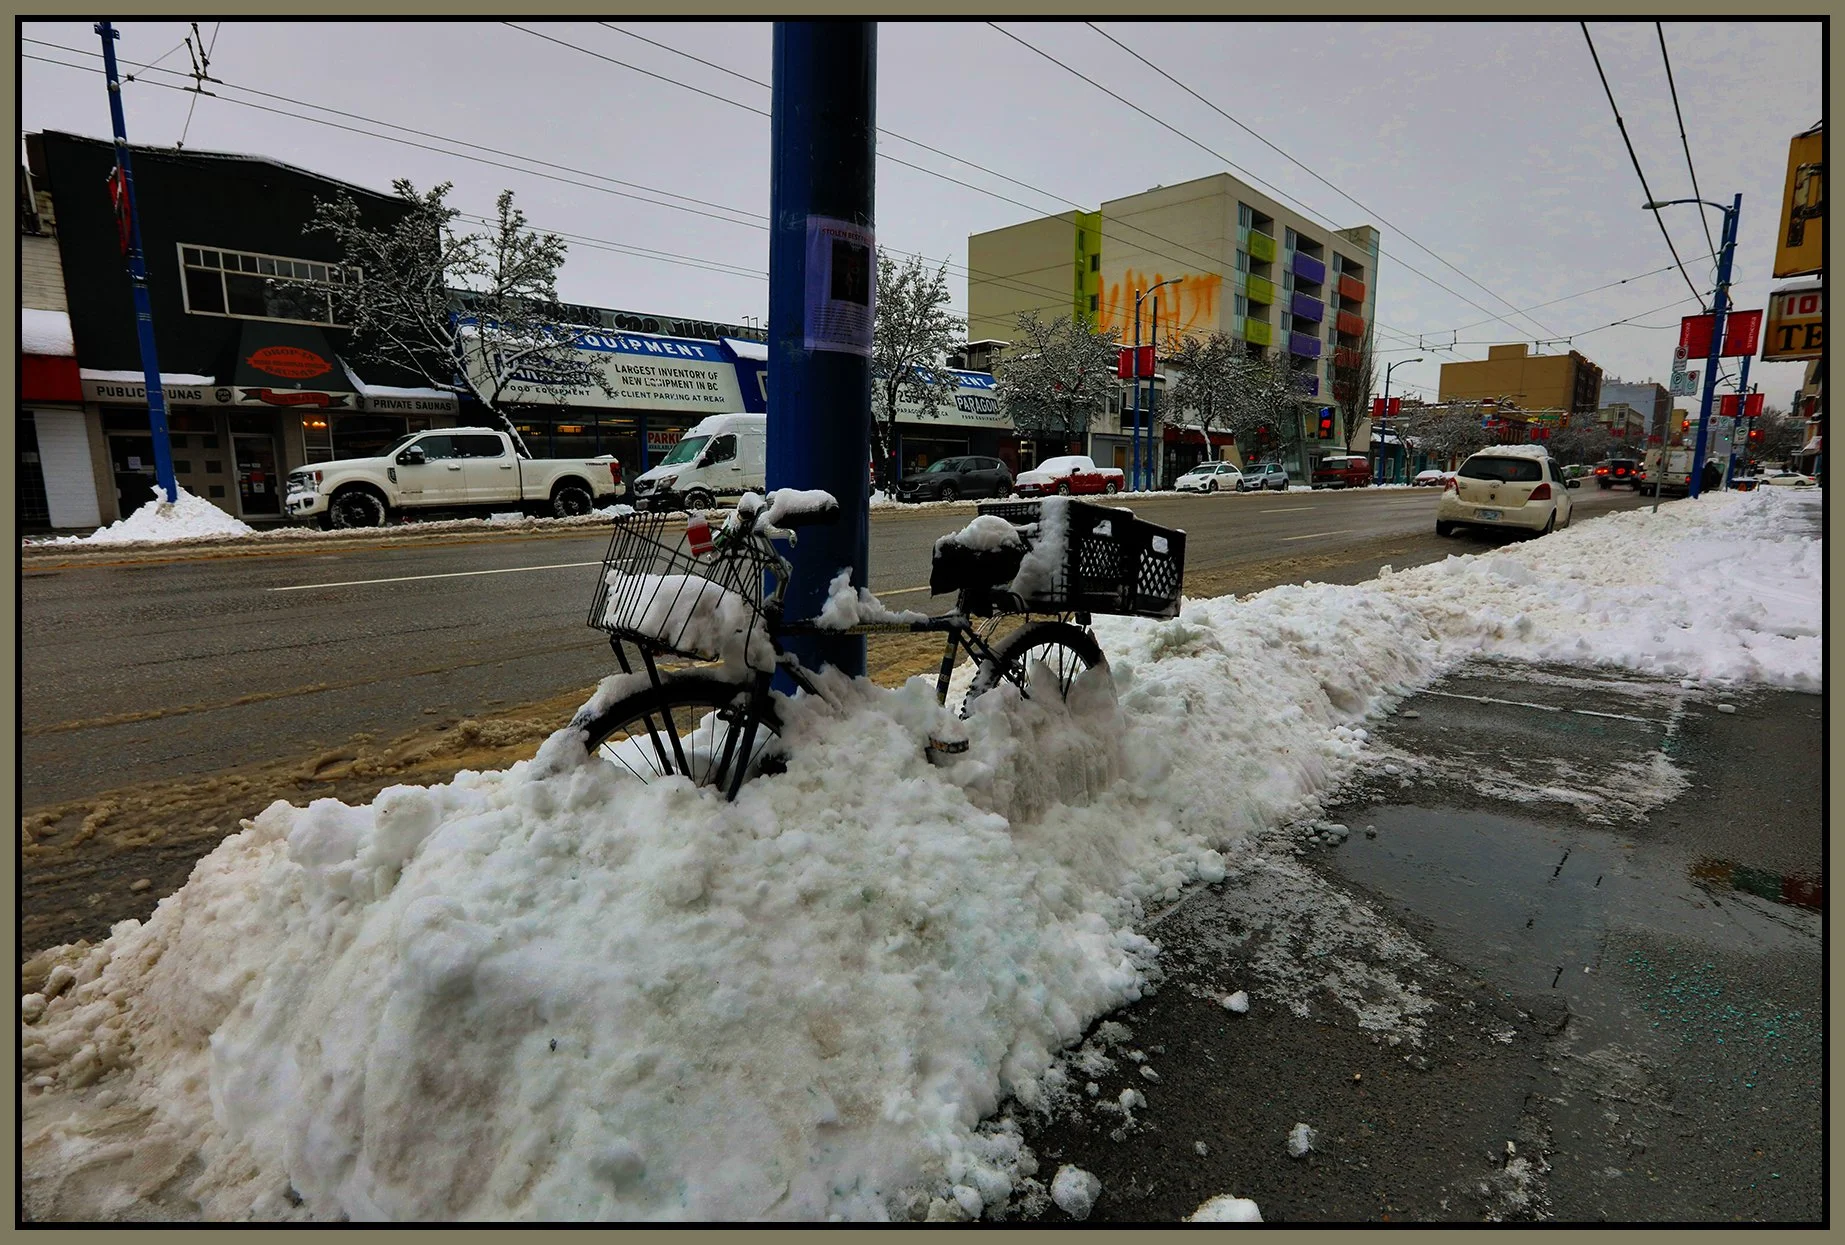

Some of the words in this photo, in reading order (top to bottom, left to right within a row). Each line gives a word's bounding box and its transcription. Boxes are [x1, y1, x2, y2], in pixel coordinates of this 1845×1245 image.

[1778, 323, 1822, 351] TE
[615, 363, 656, 376] LARGEST
[658, 367, 706, 380] INVENTORY
[708, 371, 719, 381] OF
[504, 384, 531, 393] FOOD
[622, 376, 642, 386] NEW
[696, 381, 706, 390] IN
[708, 382, 719, 391] BC
[96, 386, 145, 398] PUBLIC
[167, 389, 202, 400] UNAS
[620, 389, 651, 399] CLIENT
[653, 392, 690, 402] PARKING
[692, 394, 702, 402] AT
[704, 395, 726, 403] REAR
[374, 399, 412, 410] PRIVATE
[415, 401, 452, 411] SAUNAS
[957, 396, 998, 413] PARAGON
[648, 432, 683, 444] PARKI
